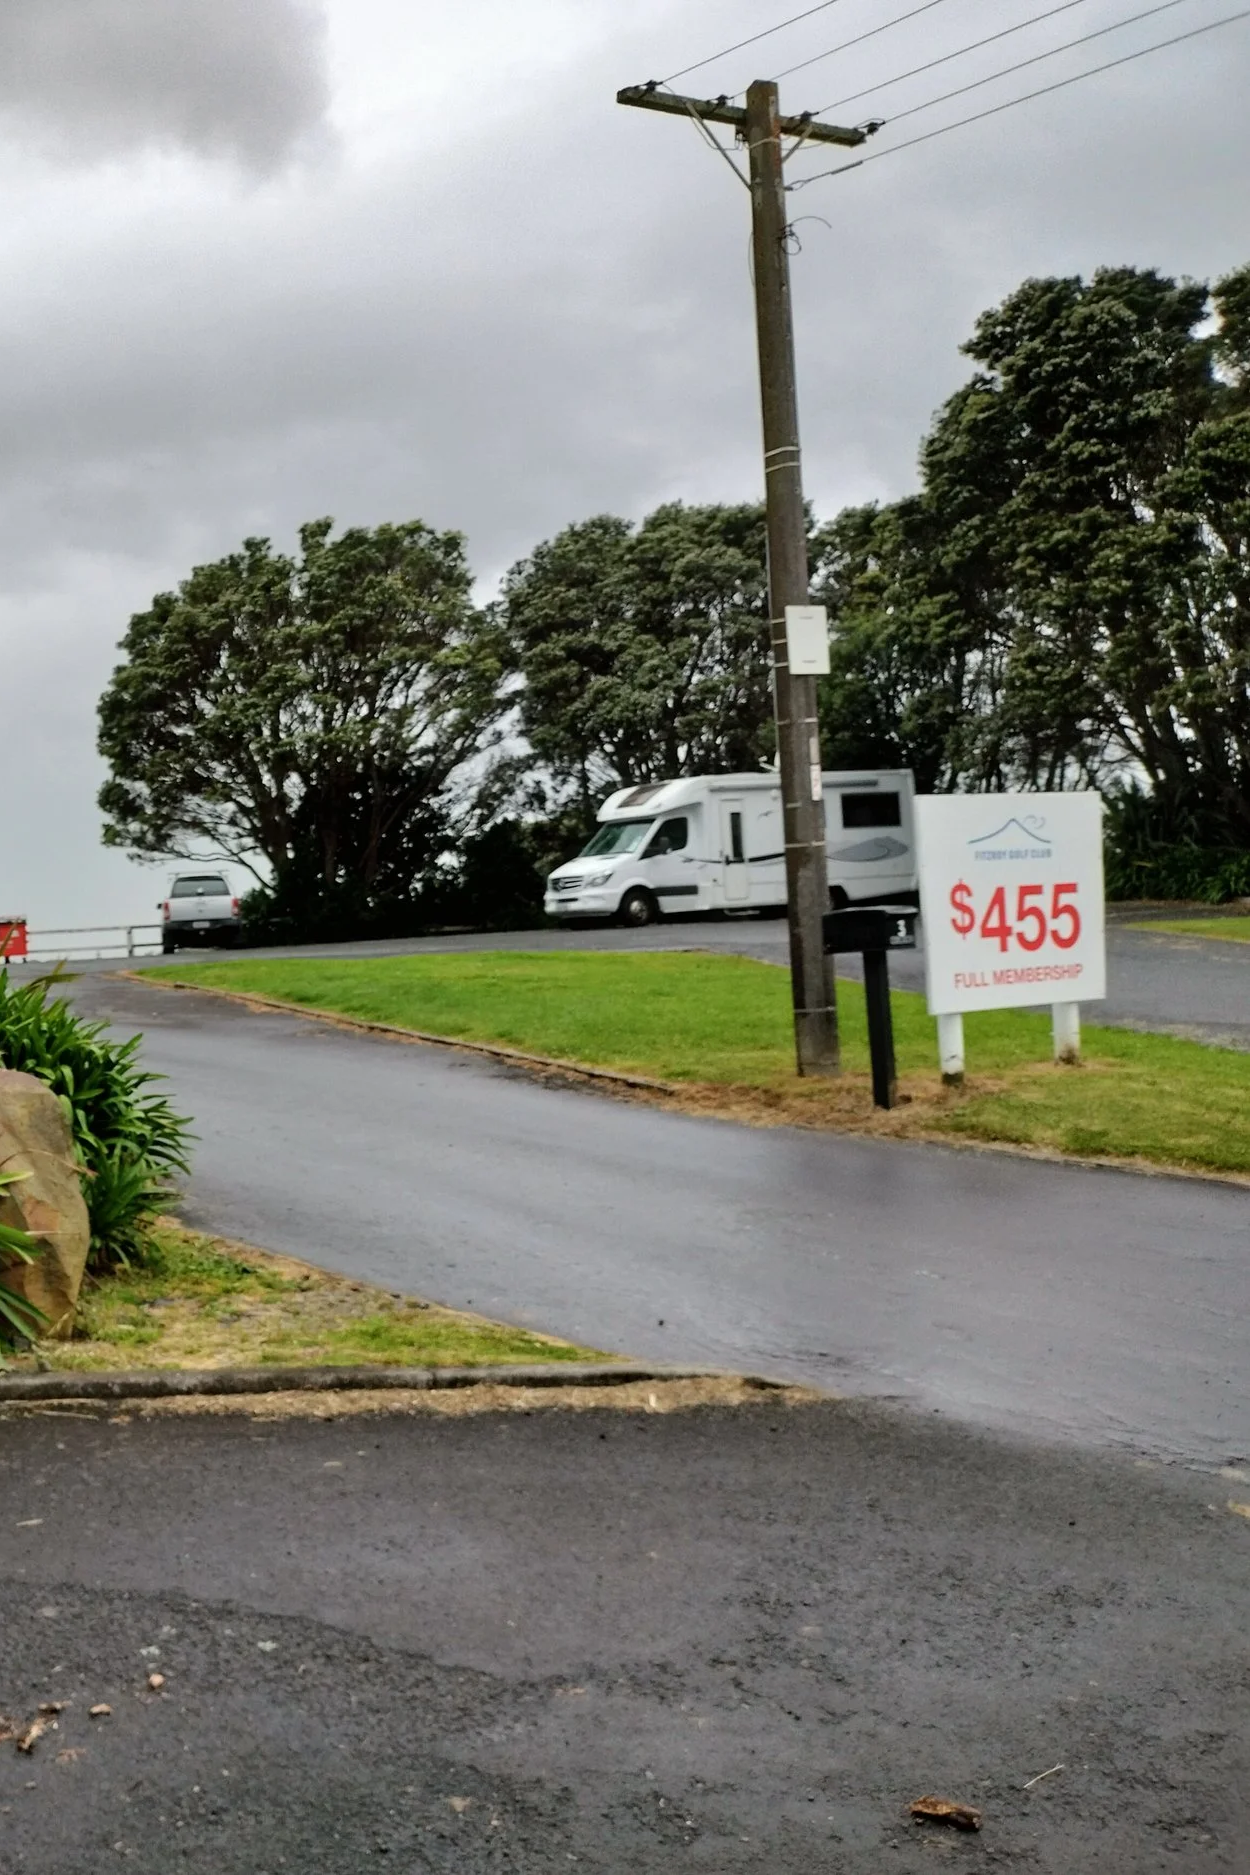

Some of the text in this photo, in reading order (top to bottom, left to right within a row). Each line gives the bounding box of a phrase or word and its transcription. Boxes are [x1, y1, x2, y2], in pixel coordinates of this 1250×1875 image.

[975, 848, 1052, 861] FITZROY GOLF CLUB
[949, 878, 1081, 952] $455
[896, 919, 907, 937] 3
[954, 964, 1083, 989] FULL MEMBERSHIP
